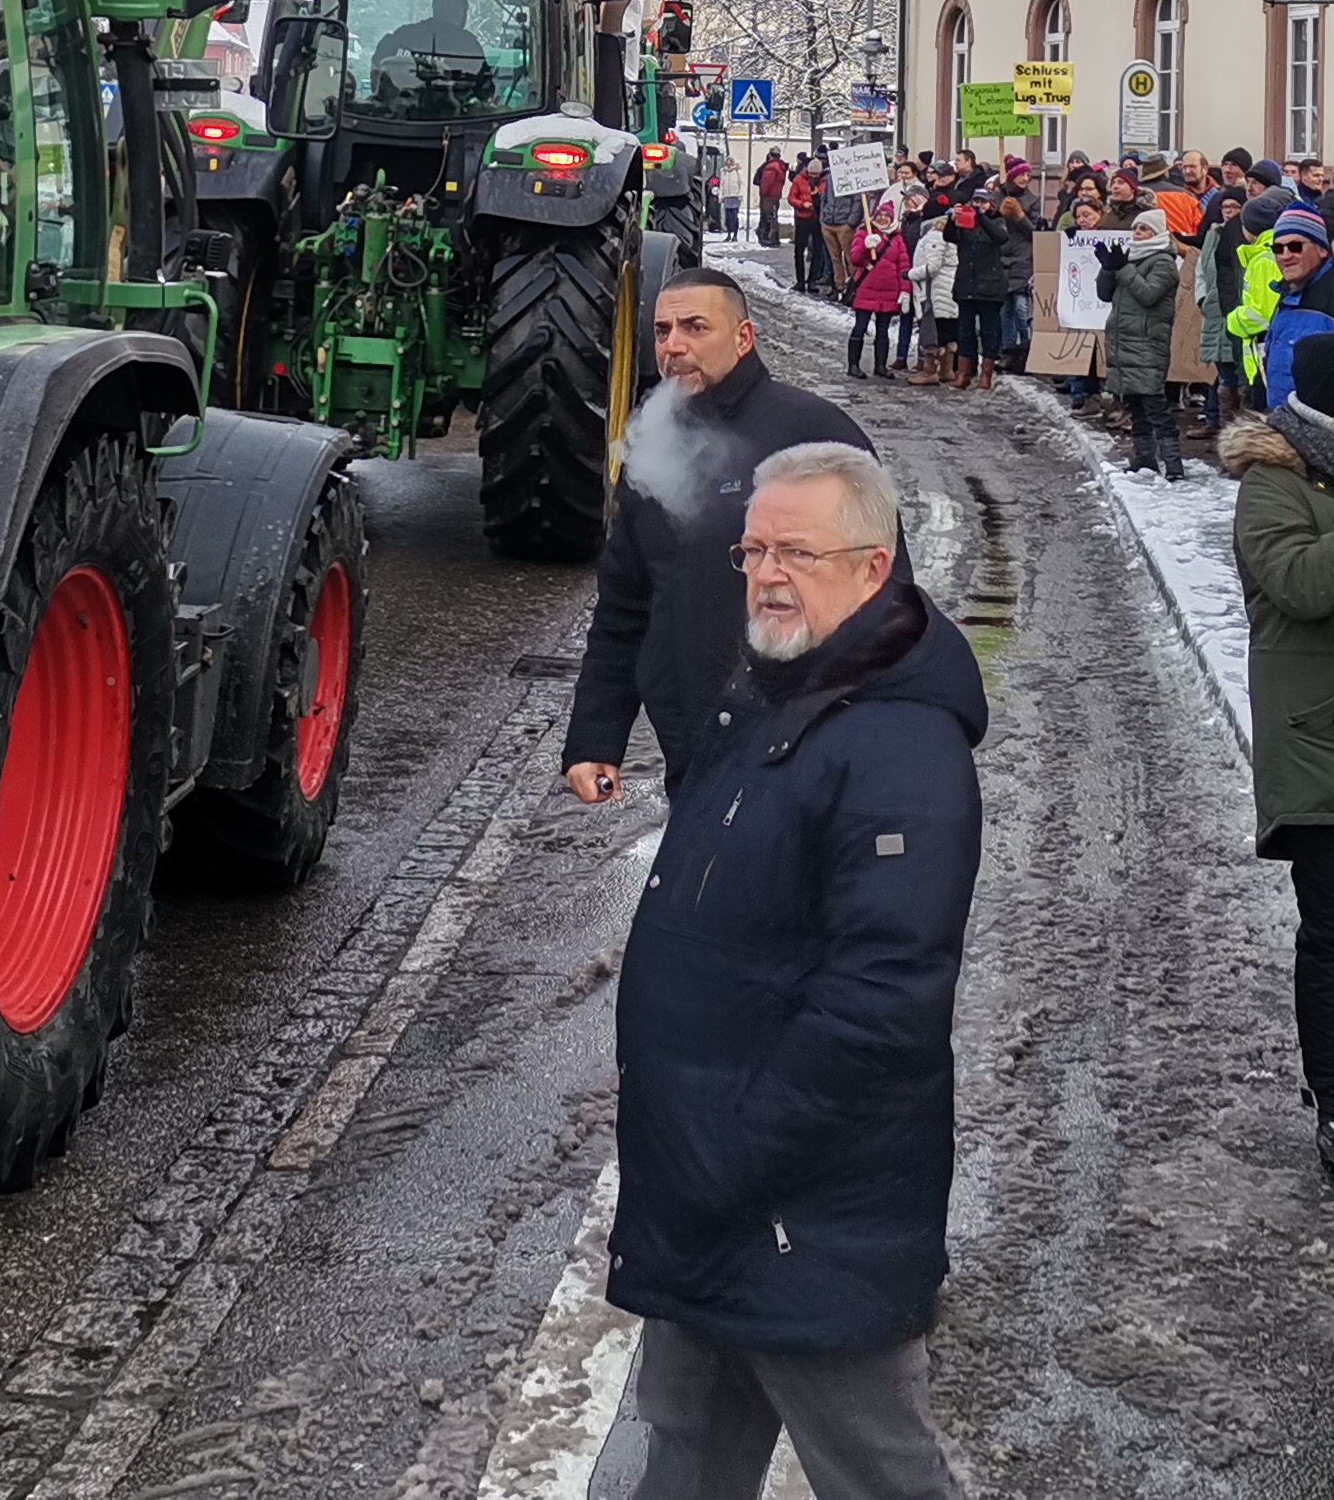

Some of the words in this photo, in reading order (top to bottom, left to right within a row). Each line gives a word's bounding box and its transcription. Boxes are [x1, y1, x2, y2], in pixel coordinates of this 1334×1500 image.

[1015, 64, 1069, 76] Schluss
[1030, 78, 1053, 89] mit
[1135, 76, 1147, 91] H
[1014, 92, 1037, 105] Lug
[1043, 92, 1071, 106] Trug
